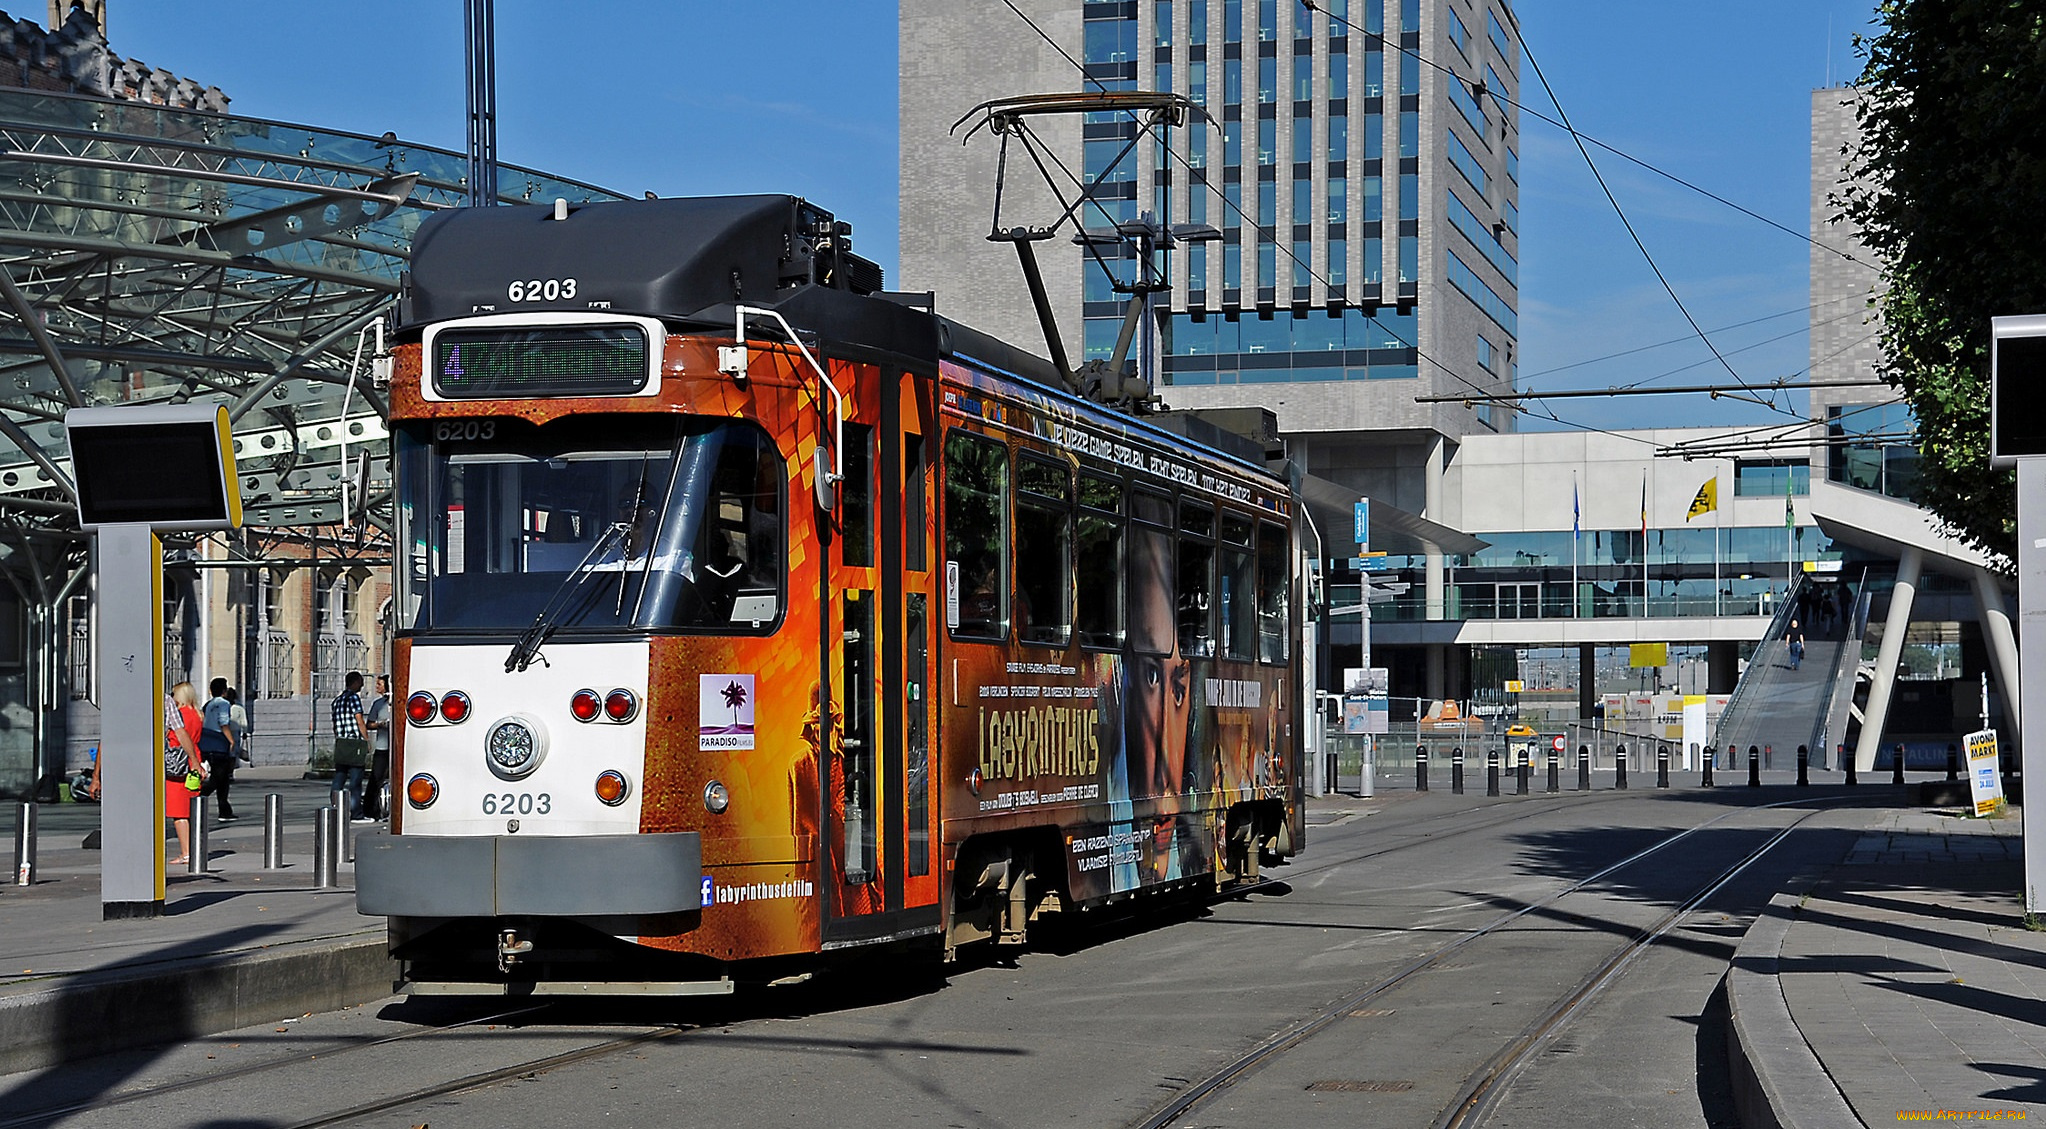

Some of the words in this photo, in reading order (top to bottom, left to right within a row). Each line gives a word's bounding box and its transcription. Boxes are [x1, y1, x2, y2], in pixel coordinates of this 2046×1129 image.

[508, 278, 577, 302] 6203
[445, 344, 464, 380] 4
[436, 421, 496, 441] 6203
[701, 737, 737, 746] PARADISO
[979, 705, 1099, 782] LABYRINTHUS
[1970, 733, 1995, 746] AVOND
[1971, 744, 1996, 759] MARKT
[482, 793, 551, 815] 6203
[1072, 839, 1087, 853] EEN
[1077, 854, 1108, 872] VLAAMSE
[716, 880, 813, 905] labyrinthusdefilm
